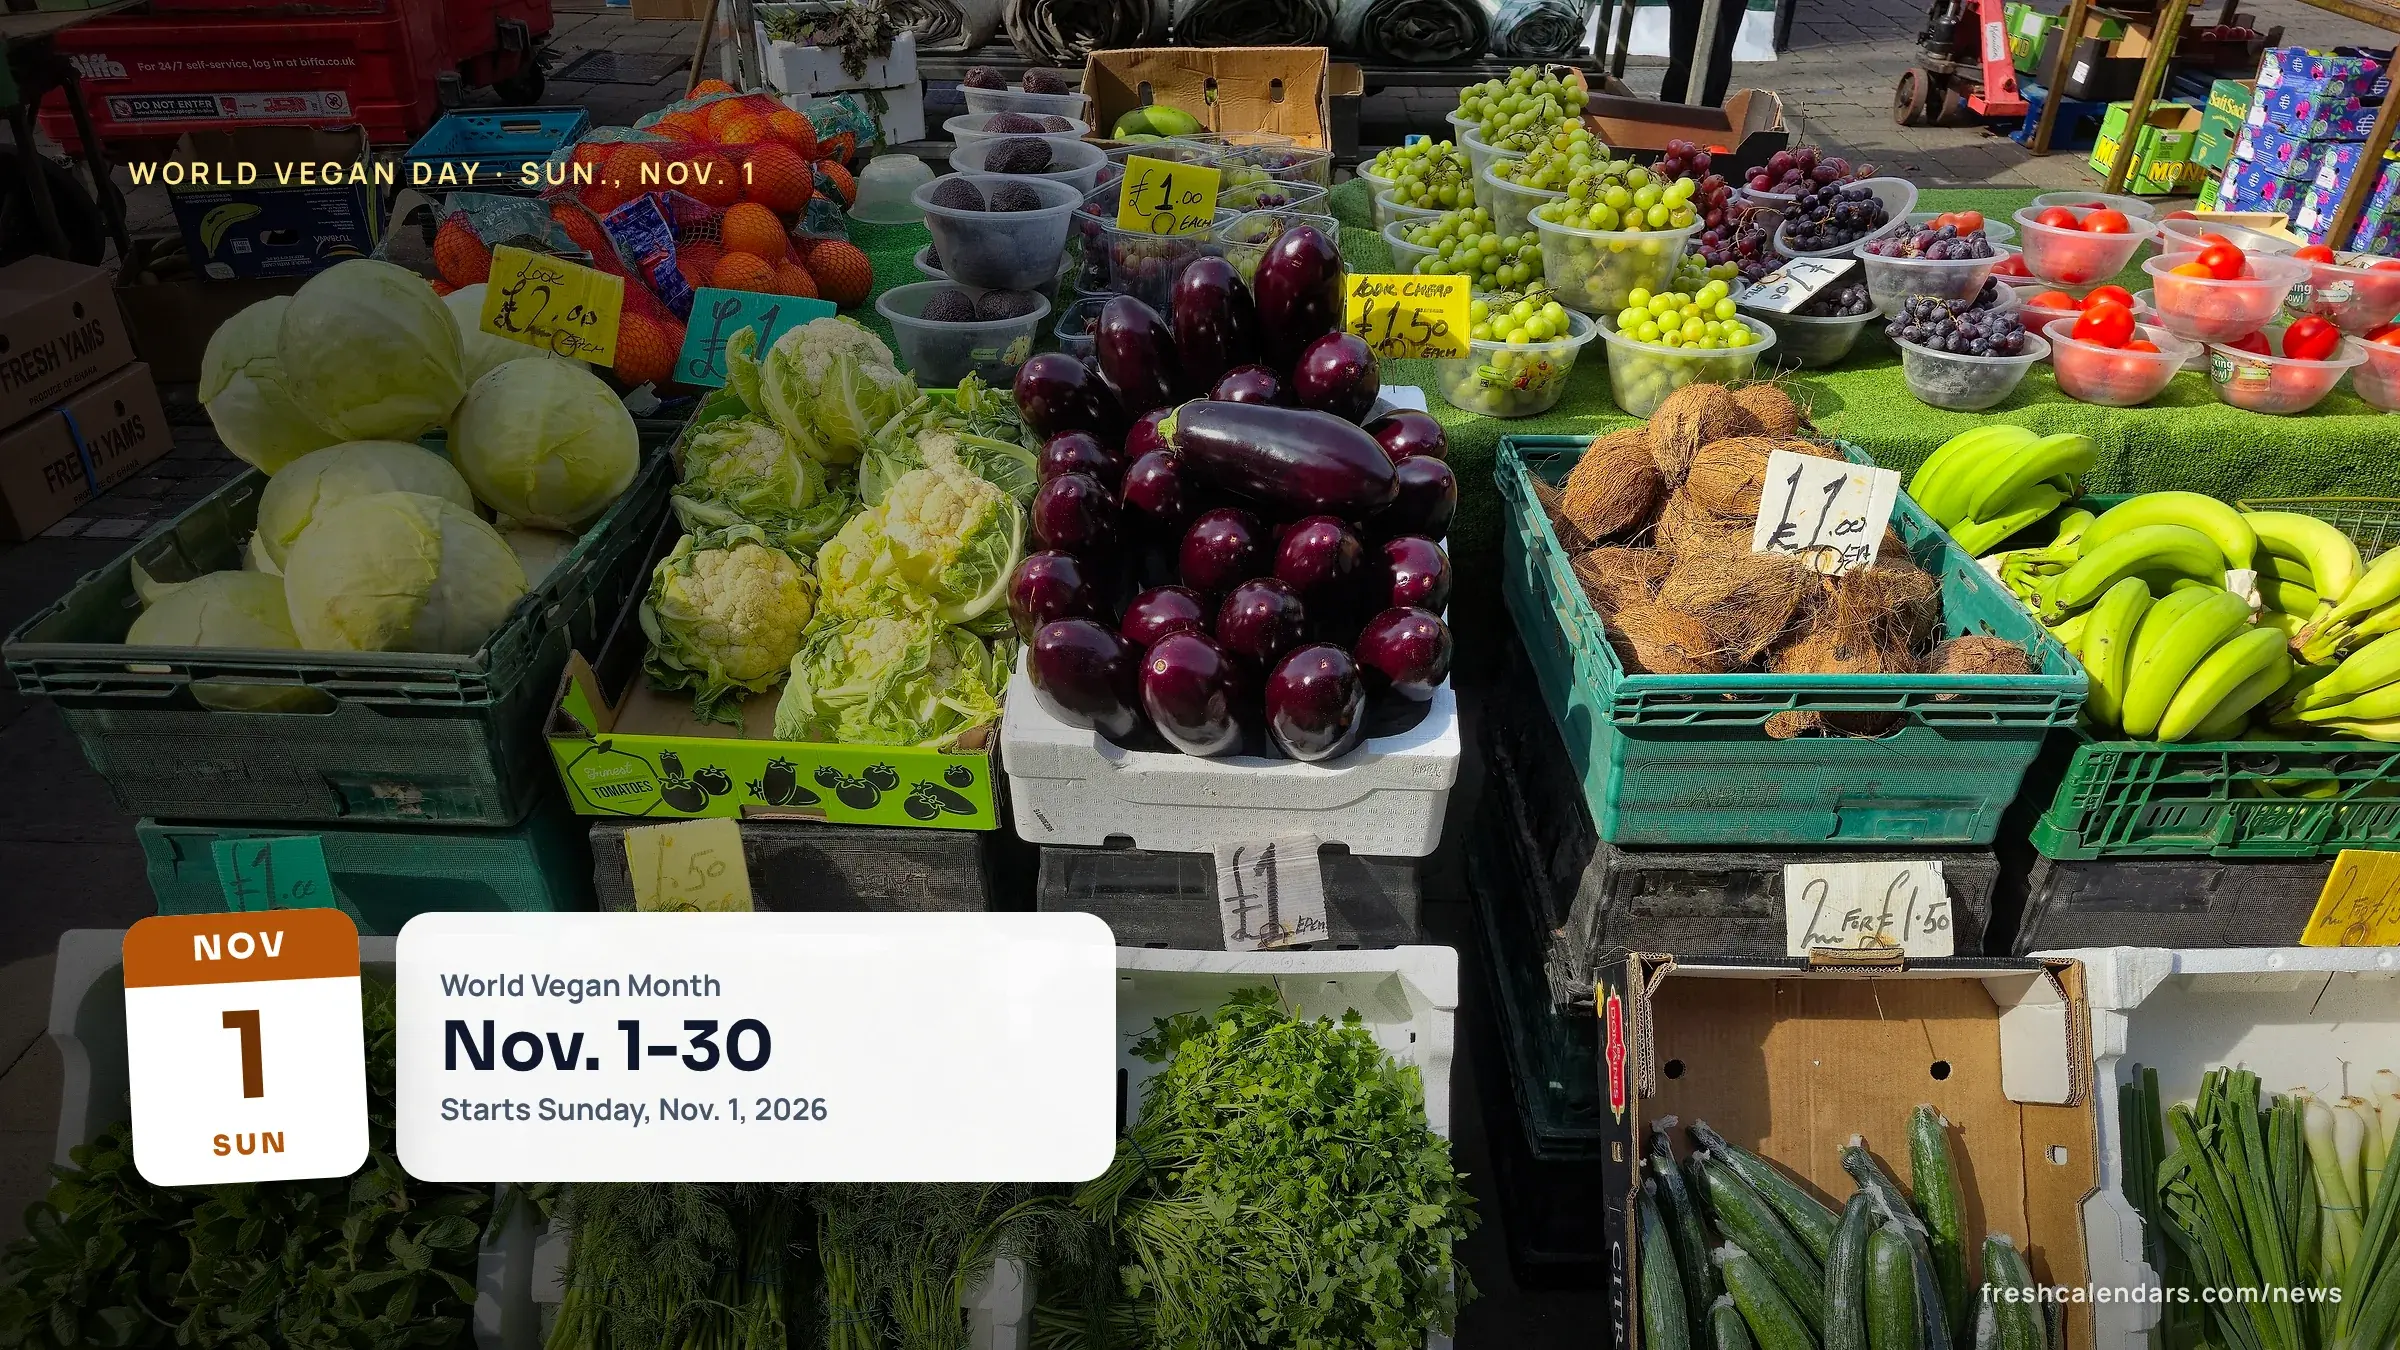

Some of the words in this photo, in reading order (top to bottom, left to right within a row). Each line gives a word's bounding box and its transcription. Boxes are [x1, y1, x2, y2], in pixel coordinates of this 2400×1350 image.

[137, 62, 156, 72] For
[157, 61, 183, 72] 24/7
[186, 58, 252, 71] self-service,
[252, 58, 271, 70] log
[272, 57, 284, 68] in
[286, 57, 298, 68] at
[299, 55, 356, 67] biffa.co.uk
[134, 101, 150, 110] DO
[151, 100, 175, 109] NOT
[179, 99, 213, 109] ENTER
[1129, 168, 1203, 217] £1.00
[1180, 214, 1214, 231] EACH
[493, 279, 598, 334] £2.00
[1354, 298, 1449, 352] £1.50
[0, 338, 61, 394] FRESH
[59, 318, 105, 363] YAMS
[29, 382, 63, 406] PRODUCE
[63, 378, 73, 388] OF
[74, 364, 98, 384] GHANA
[43, 440, 104, 494] FREH
[100, 414, 146, 459] YAMS
[105, 474, 116, 488] OF
[116, 458, 140, 479] GHANA
[583, 760, 633, 780] Finest
[591, 780, 655, 799] TOMATOES
[1801, 878, 1844, 949] 2
[1866, 869, 1950, 948] £1.50
